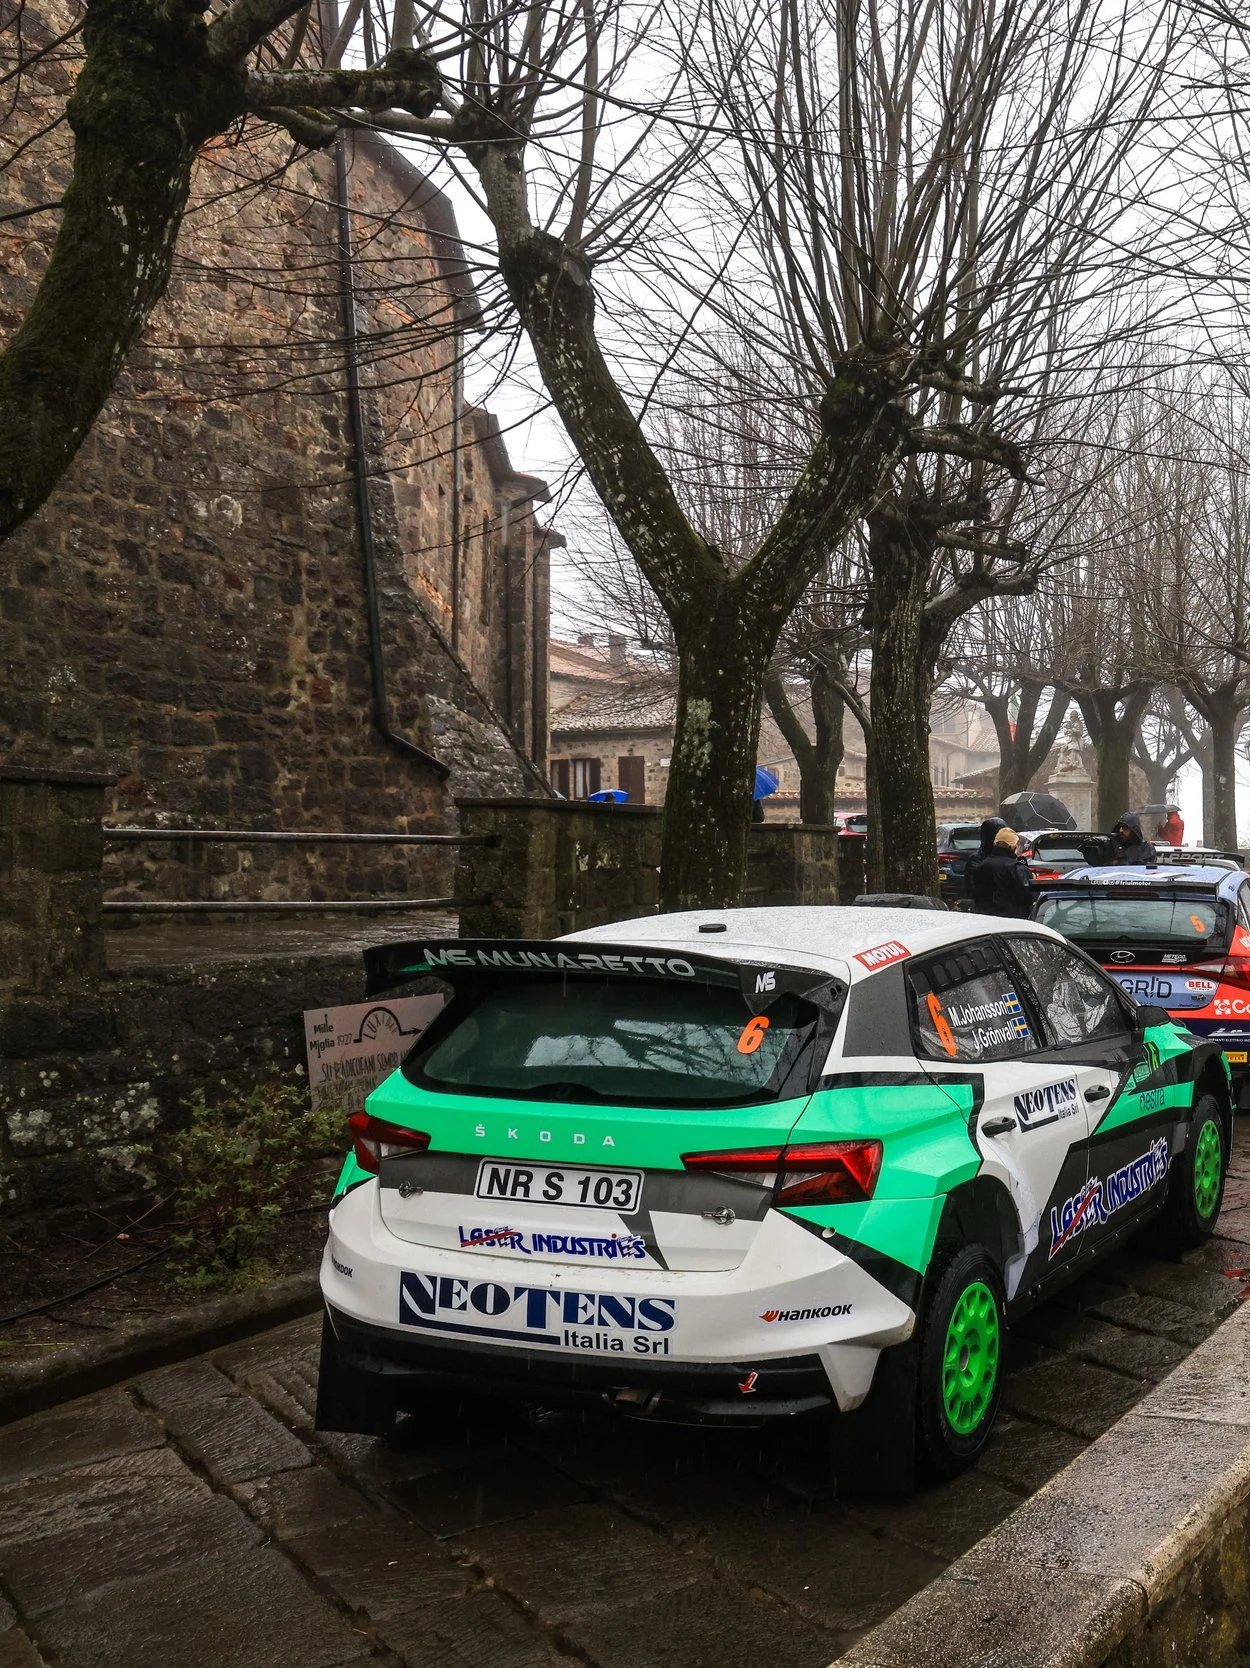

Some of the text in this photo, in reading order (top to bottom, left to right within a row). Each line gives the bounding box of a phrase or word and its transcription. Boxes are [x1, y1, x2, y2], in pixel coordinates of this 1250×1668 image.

[1189, 915, 1206, 933] 5
[476, 950, 696, 977] MUNARETTO
[862, 942, 906, 967] MOTUL
[754, 971, 776, 994] MS
[1188, 981, 1213, 989] BELL
[313, 1014, 334, 1035] Mille
[927, 992, 957, 1057] 6
[948, 1000, 1008, 1027] M.Johansson
[309, 1033, 353, 1057] Miglia 1927
[737, 1015, 770, 1055] 6
[1014, 1079, 1077, 1123] NEOTENS
[1058, 1103, 1080, 1119] Italia Srl
[475, 1123, 616, 1147] ŠKODA
[486, 1167, 634, 1207] NR S 103
[1051, 1137, 1168, 1256] LASER INDUSTRIES
[458, 1225, 647, 1259] LASER INDUSTRIES
[399, 1271, 676, 1336] NEOTENS
[563, 1330, 669, 1355] Italia Srl
